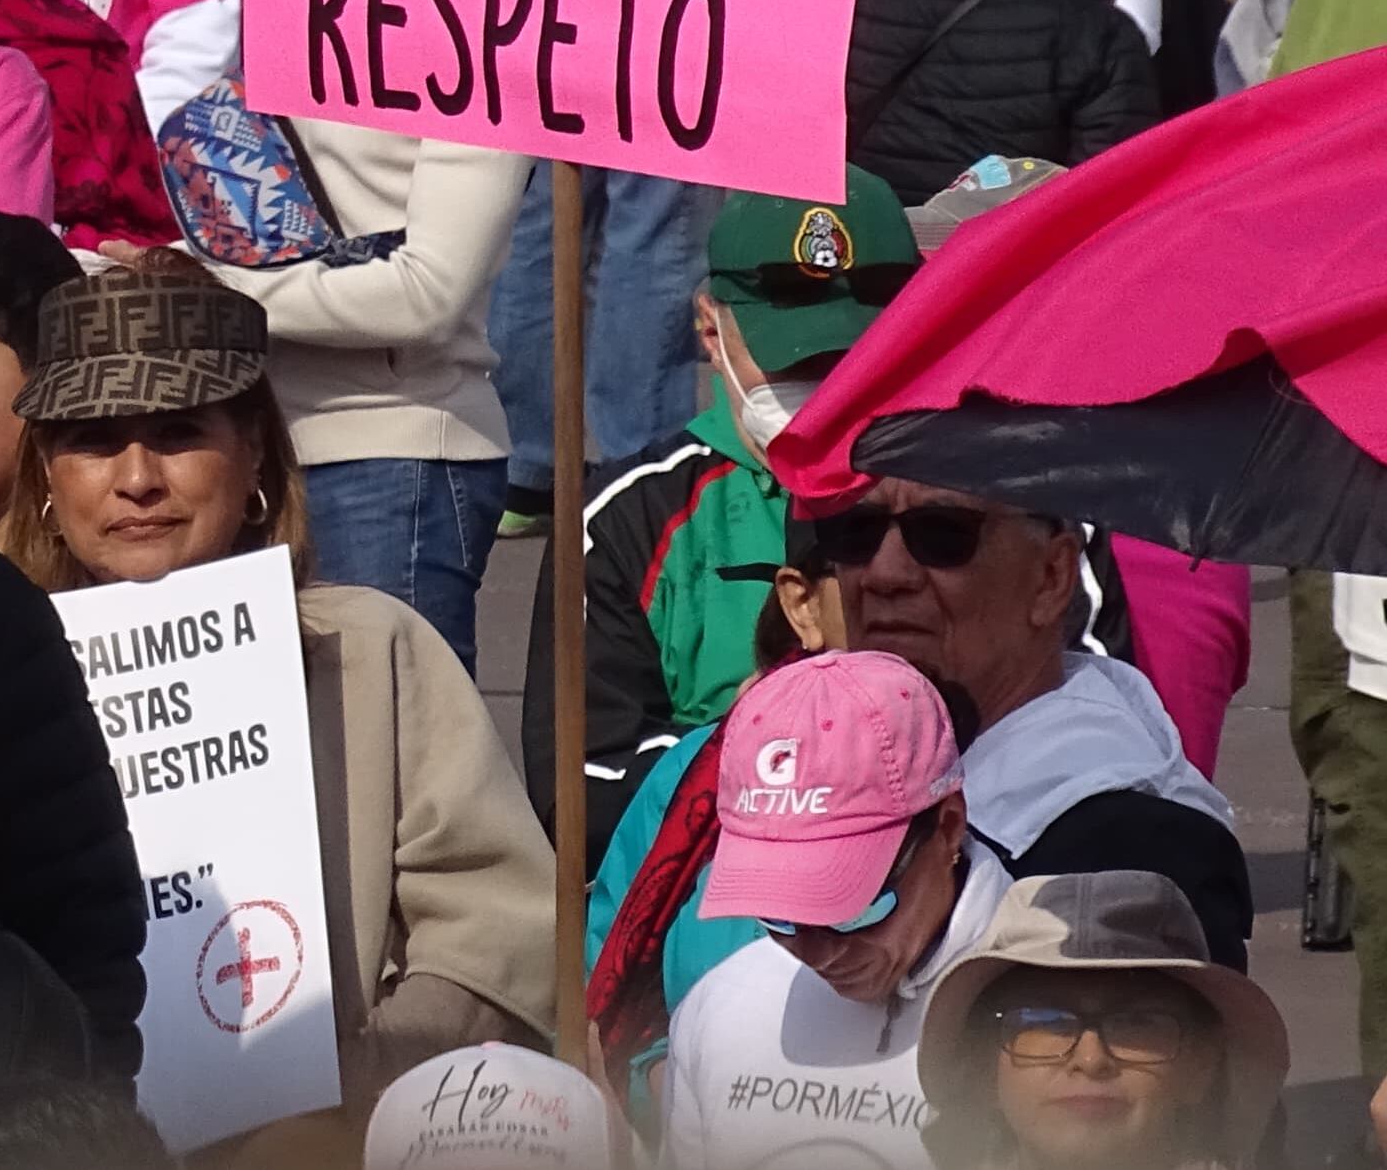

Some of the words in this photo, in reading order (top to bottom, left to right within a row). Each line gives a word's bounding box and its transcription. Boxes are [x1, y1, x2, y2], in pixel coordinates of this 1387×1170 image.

[233, 602, 257, 647] A
[113, 723, 269, 799] UESTRAS
[735, 787, 833, 814] ACTIVE
[422, 1059, 514, 1128] Hoy
